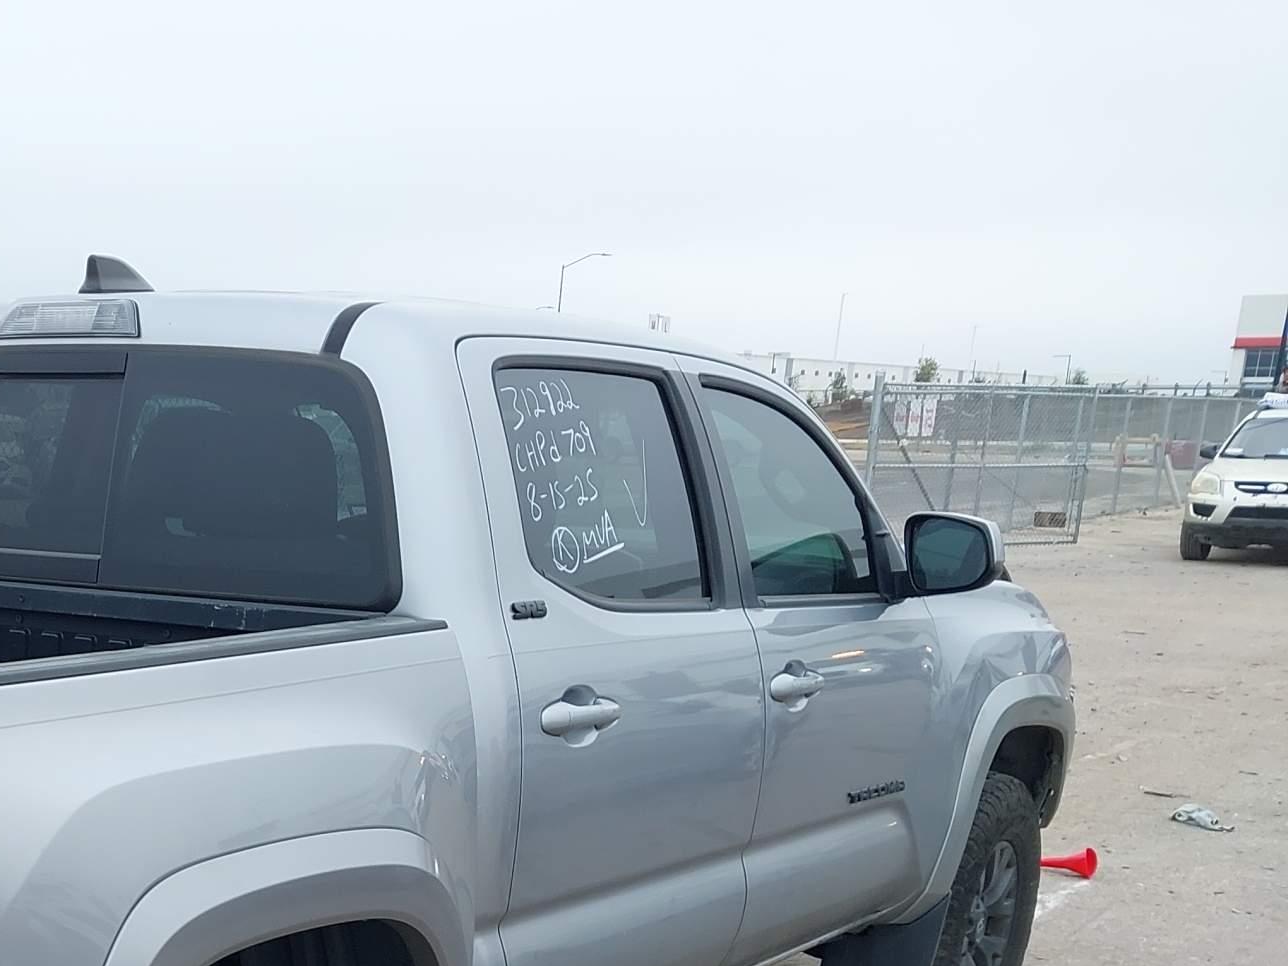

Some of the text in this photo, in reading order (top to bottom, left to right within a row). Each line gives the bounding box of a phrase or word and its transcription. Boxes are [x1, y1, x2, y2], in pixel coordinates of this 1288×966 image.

[500, 379, 579, 430] 312922
[561, 421, 596, 456] 709
[526, 467, 598, 522] 8-15-25
[582, 509, 618, 559] MVA
